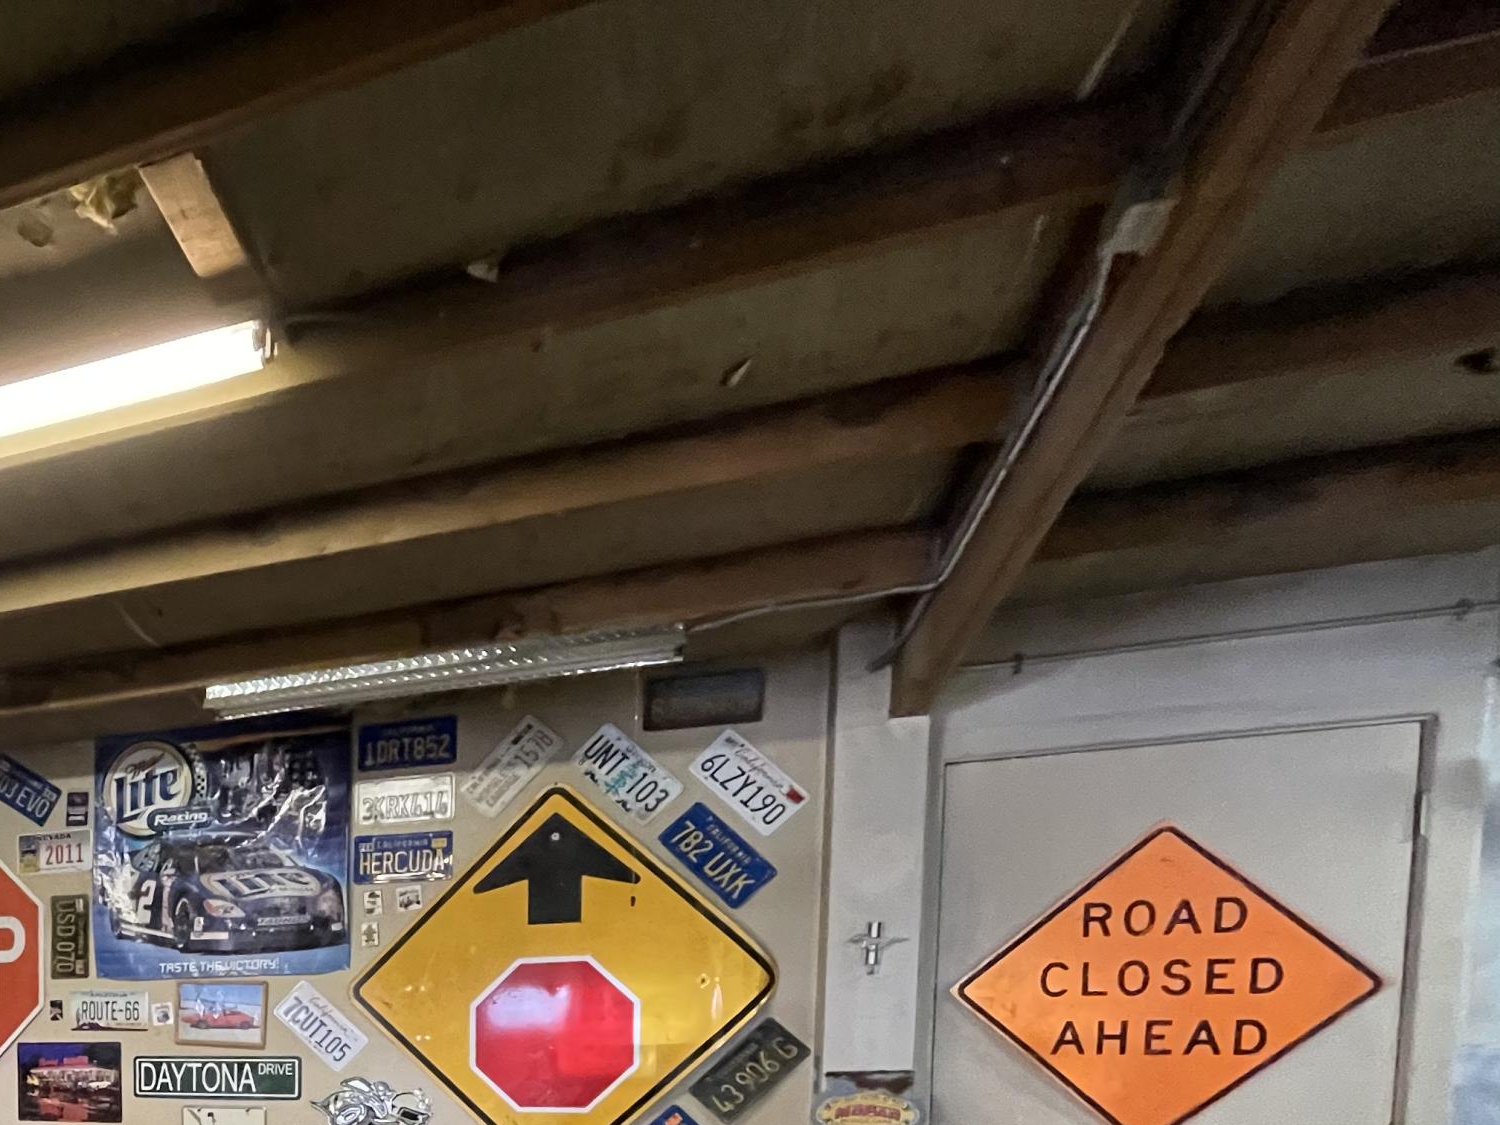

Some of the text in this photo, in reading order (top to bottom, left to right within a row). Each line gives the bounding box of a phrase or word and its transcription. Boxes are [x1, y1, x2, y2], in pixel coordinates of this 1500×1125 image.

[583, 734, 670, 813] UNT 103
[700, 753, 786, 825] 6LZY190
[16, 786, 51, 818] EVO
[114, 768, 181, 824] Lite
[154, 811, 208, 826] Racing
[45, 843, 84, 866] 2011
[359, 848, 446, 876] HERCUDA
[670, 820, 756, 900] 782 UXK
[1082, 896, 1249, 938] ROAD
[56, 900, 76, 974] USD 070
[159, 962, 197, 974] TASTE
[200, 961, 222, 972] THE
[1040, 957, 1285, 998] CLOSED
[81, 1000, 140, 1021] ROUTE-66
[282, 995, 352, 1062] 7CUT105
[1050, 1019, 1269, 1056] AHEAD
[140, 1062, 293, 1093] DAYTONA DRIVE
